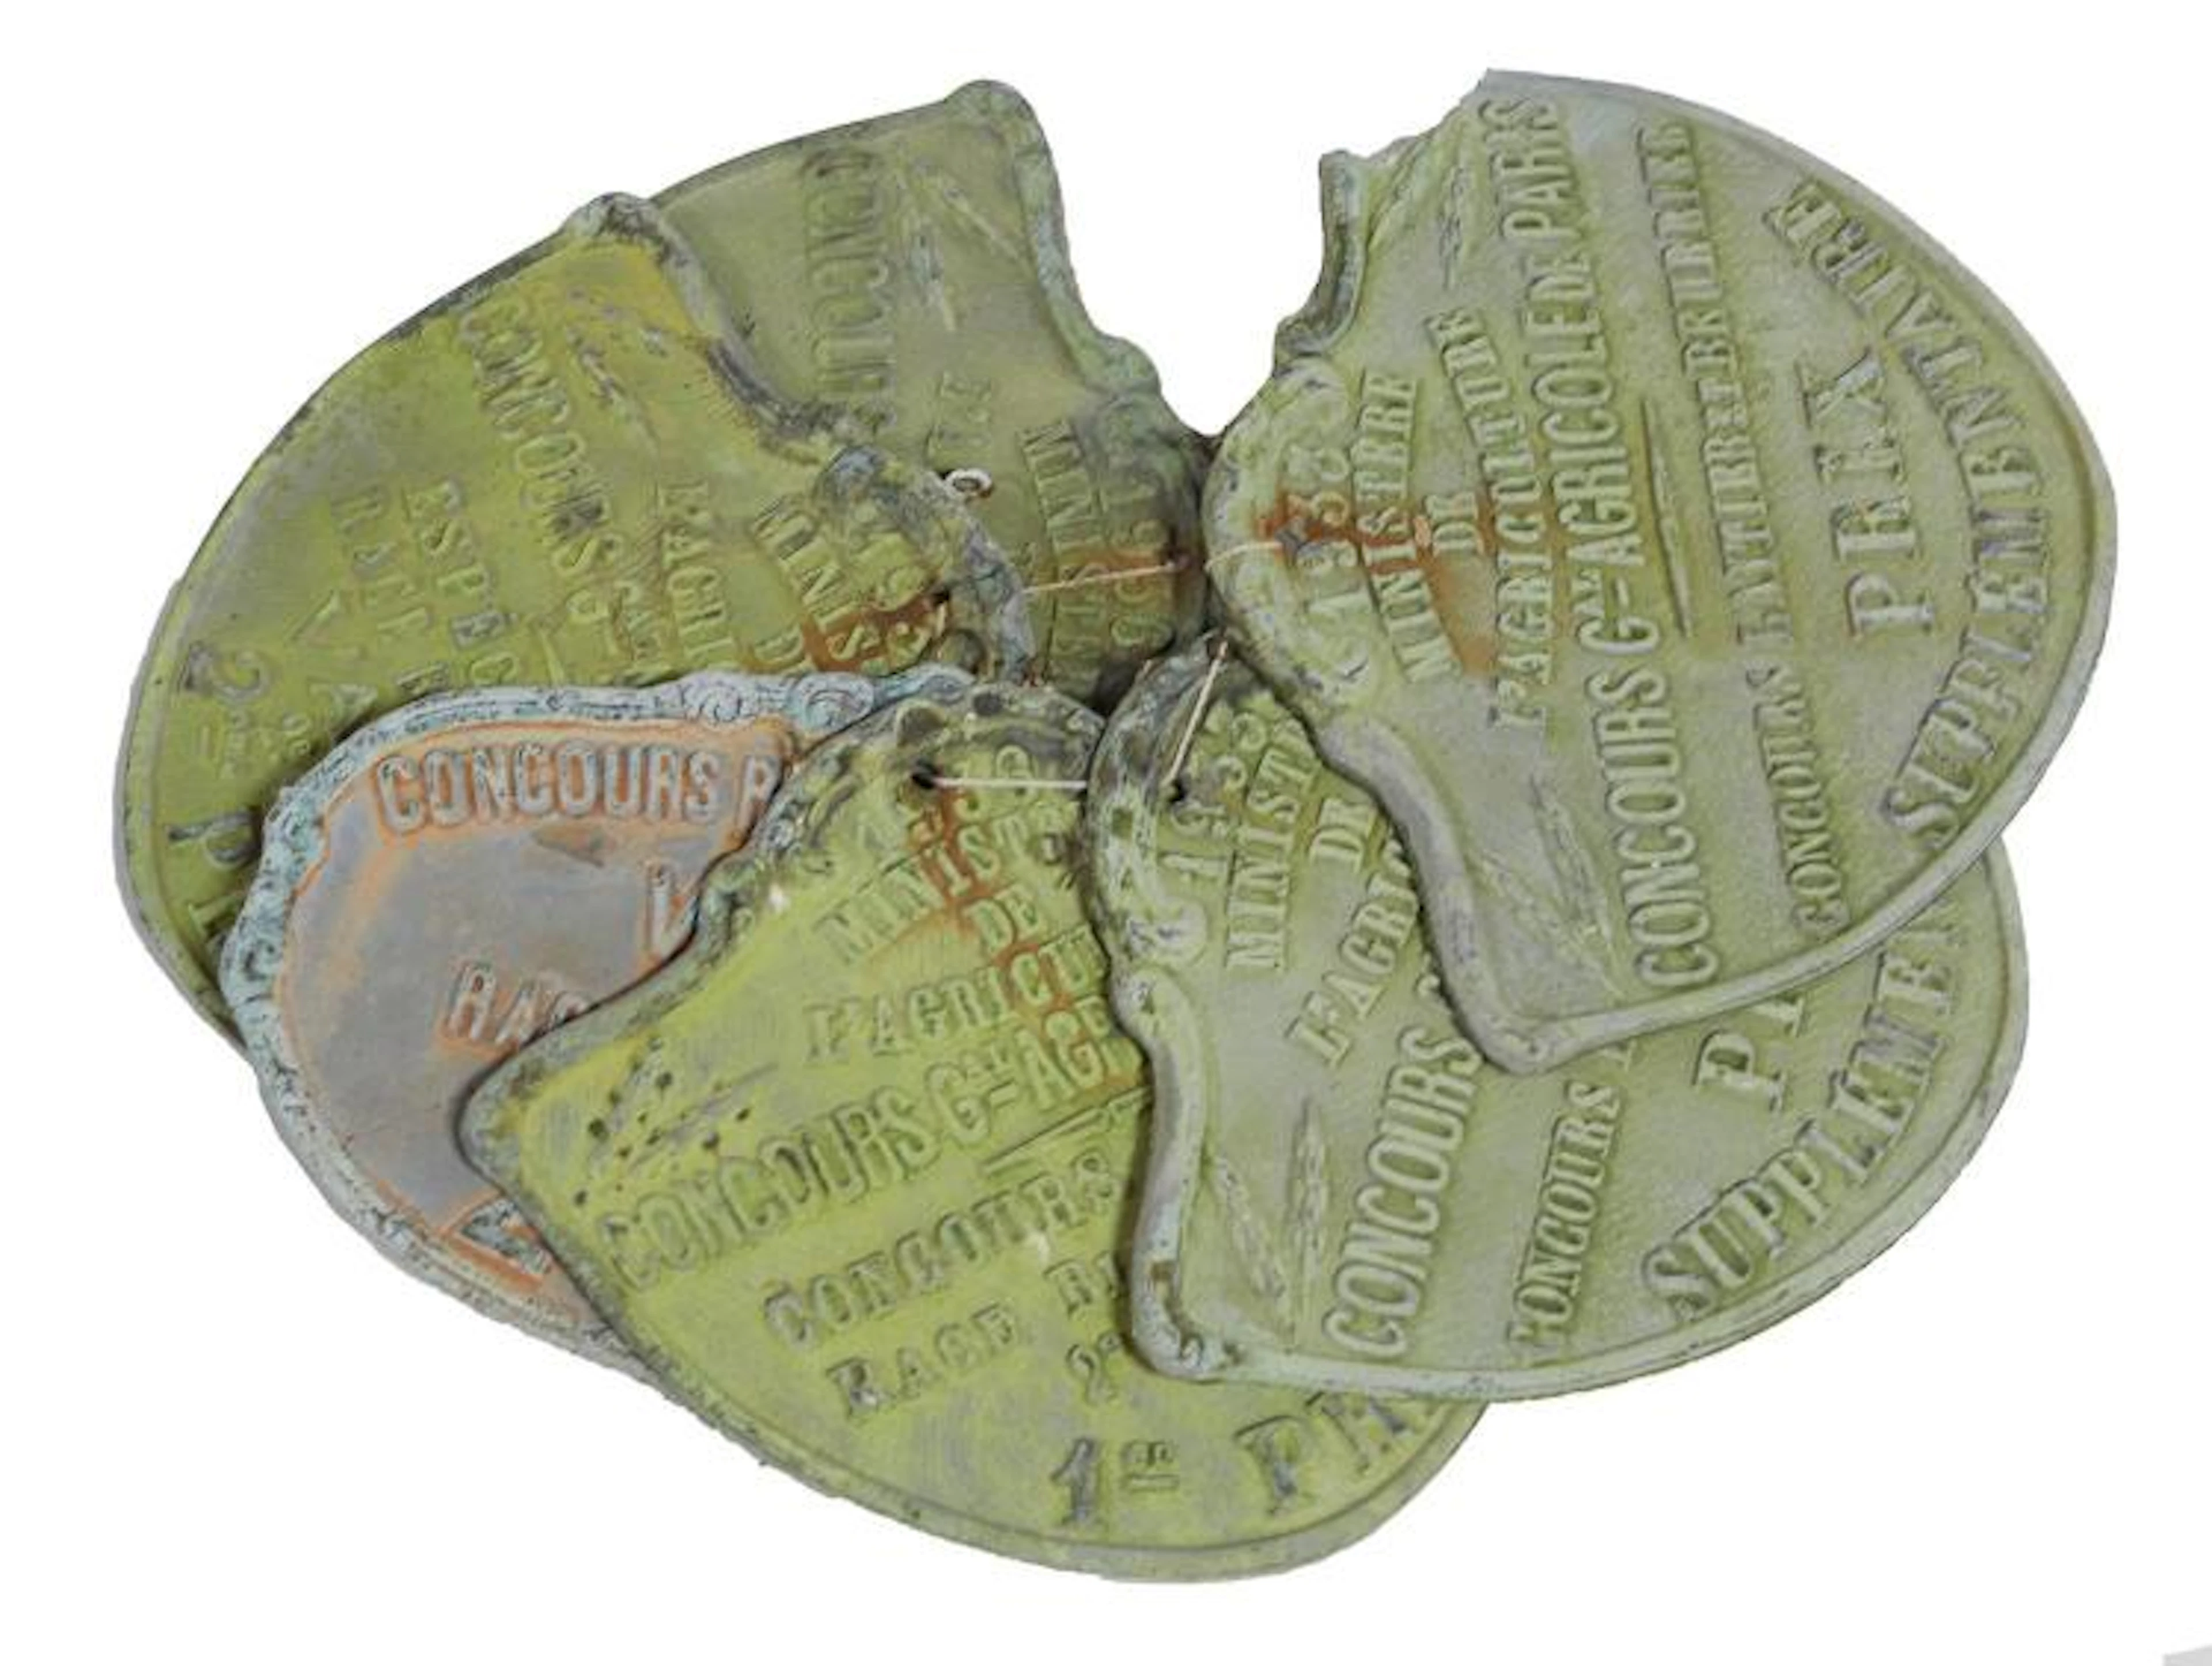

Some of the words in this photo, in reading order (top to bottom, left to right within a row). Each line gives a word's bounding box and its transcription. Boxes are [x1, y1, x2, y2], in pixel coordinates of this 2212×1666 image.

[1478, 97, 1582, 238] PARIS
[1521, 252, 1598, 306] DE
[1521, 308, 1645, 567] AGRICOLE
[1796, 348, 1936, 636] PRIX
[403, 482, 516, 685] ESPEC
[753, 496, 880, 663] MINIS
[1426, 493, 1484, 556] DE
[373, 739, 721, 834] CONCOURS
[1309, 798, 1377, 870] DE
[1587, 667, 1719, 988] CONCOURS
[1746, 660, 1849, 931] CONCOURS
[805, 926, 1108, 1065] L'AGRICU
[965, 886, 1039, 954] DE
[599, 1085, 941, 1291] CONCOURS
[765, 1150, 1116, 1349] CONCOURS
[1326, 1027, 1483, 1357] CONCOURS
[827, 1299, 1017, 1418] RACE
